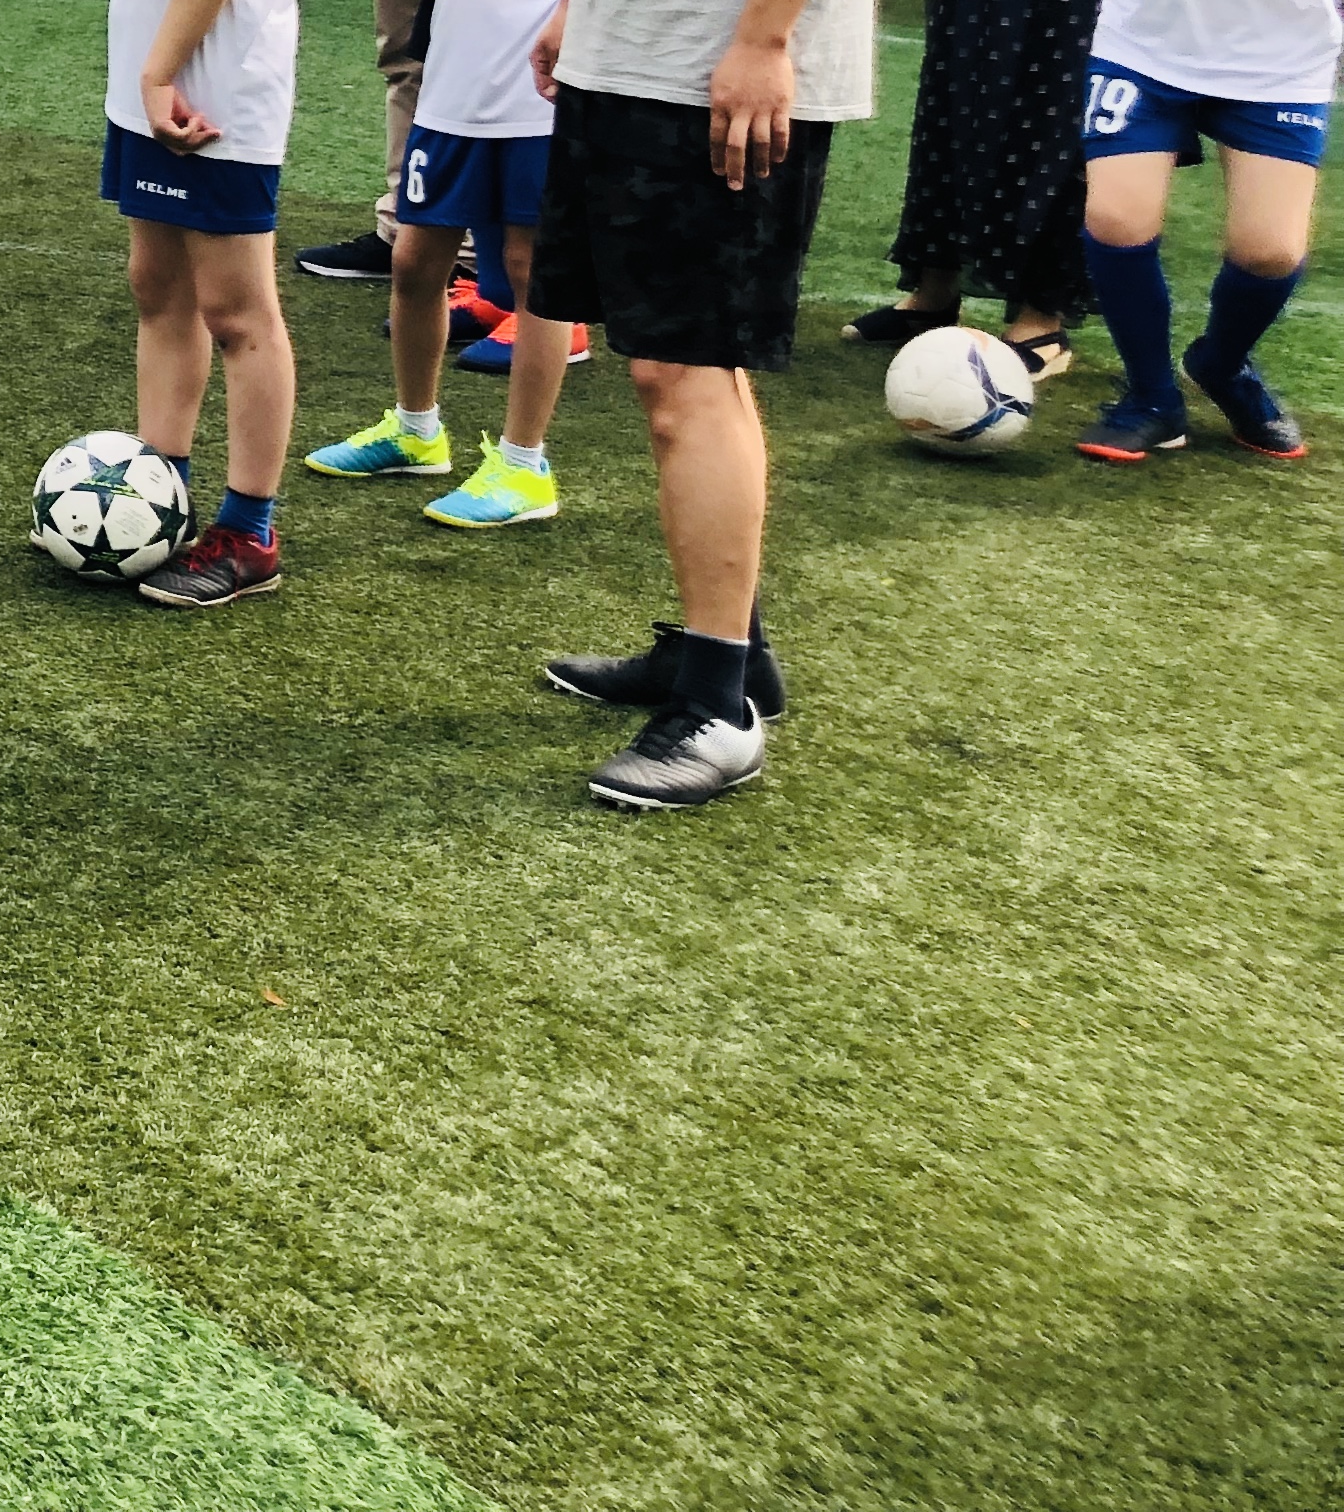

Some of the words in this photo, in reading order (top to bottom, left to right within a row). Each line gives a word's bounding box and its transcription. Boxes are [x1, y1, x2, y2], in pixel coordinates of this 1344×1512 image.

[1084, 74, 1140, 135] 19
[135, 179, 189, 200] KELME
[406, 148, 429, 204] 6
